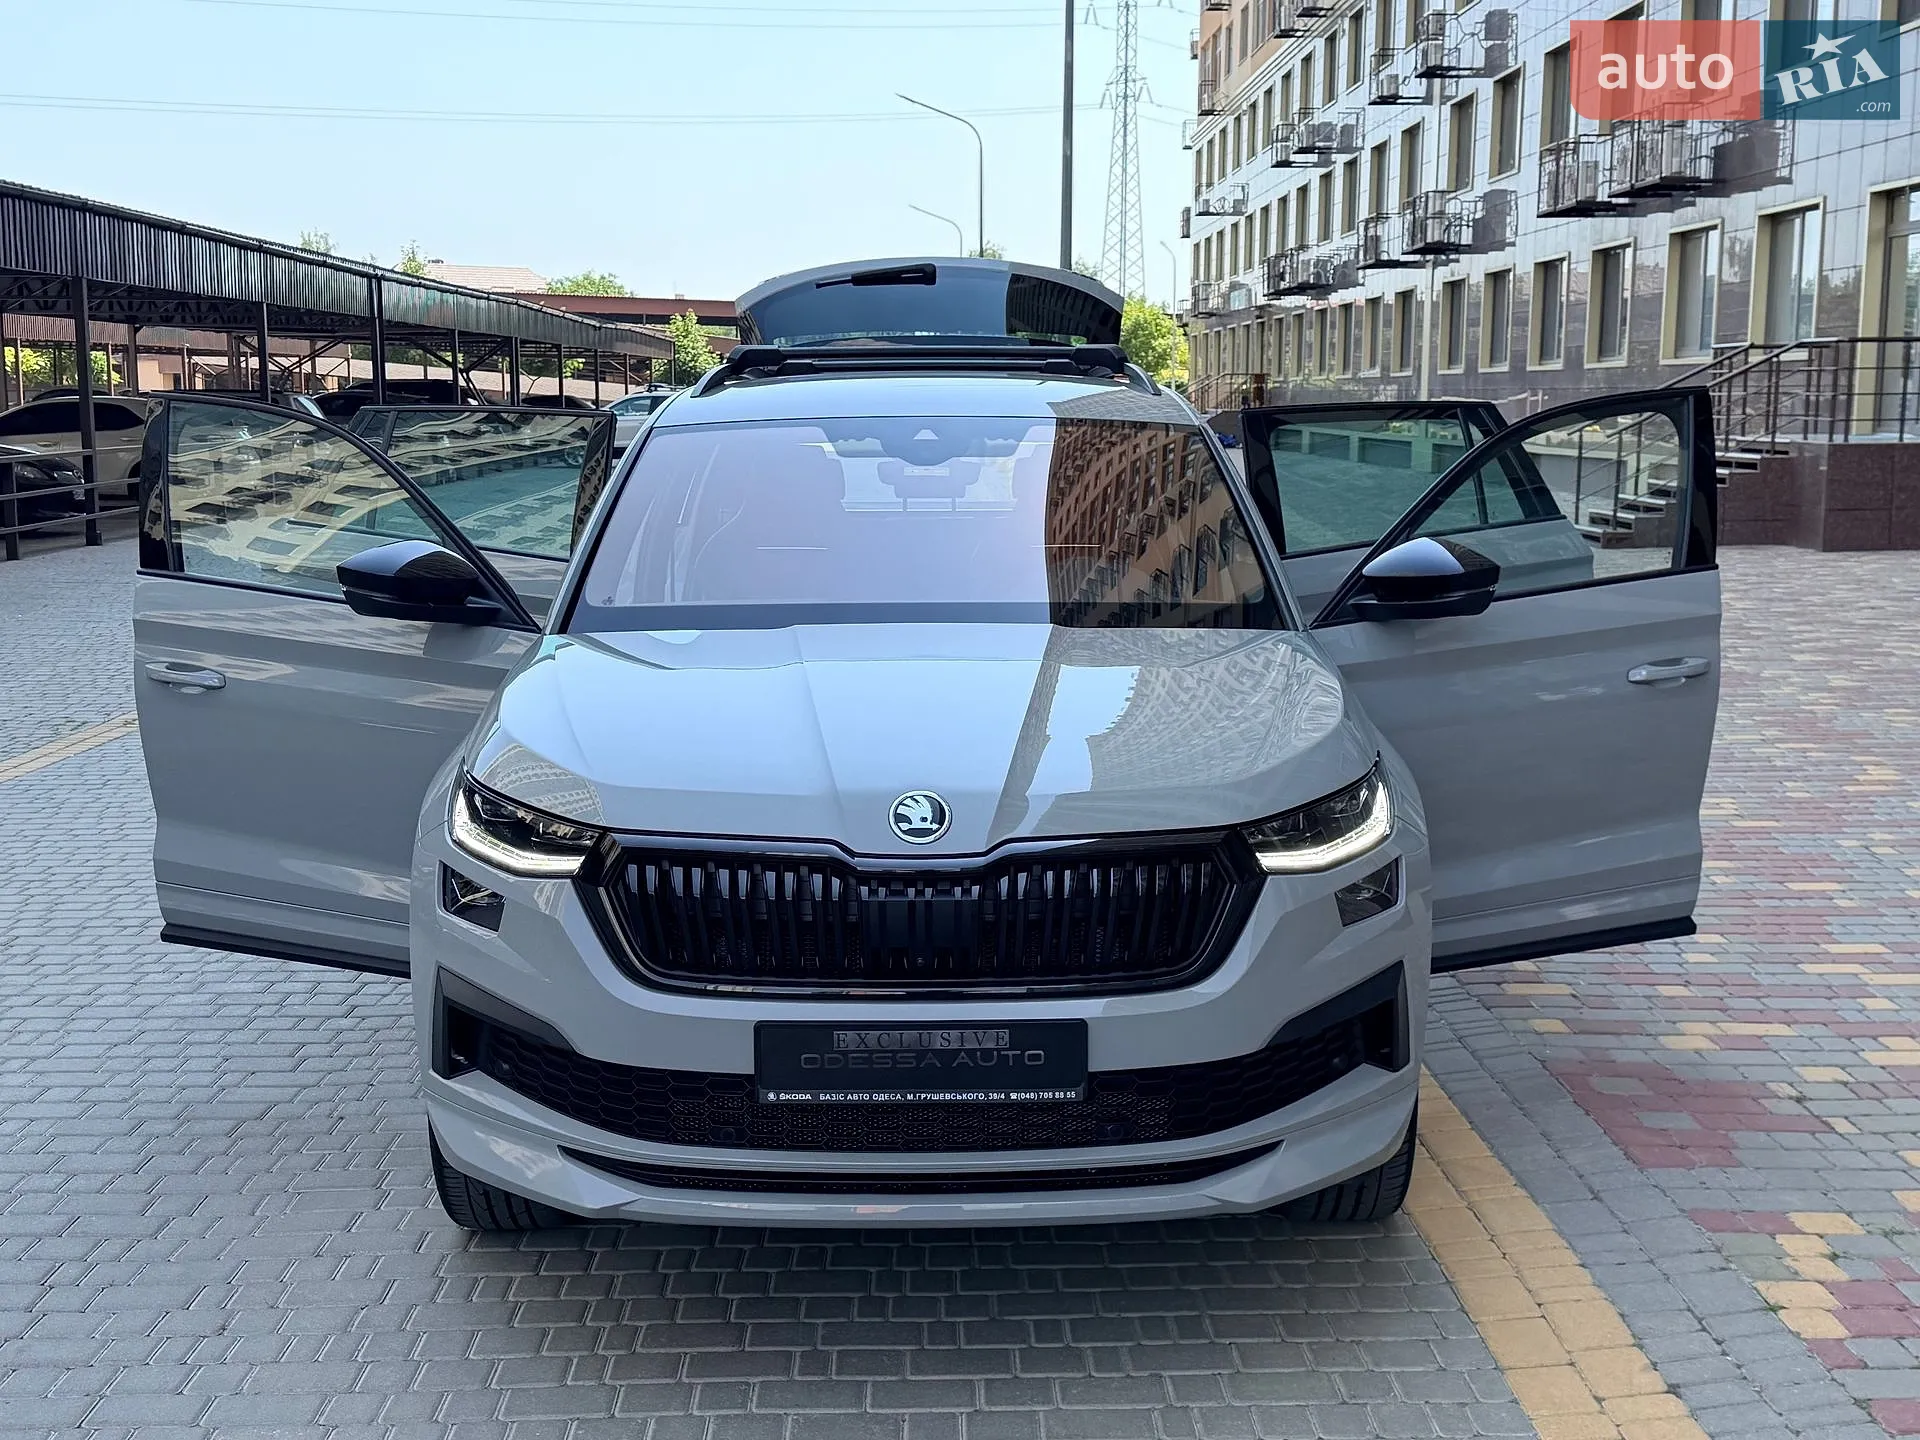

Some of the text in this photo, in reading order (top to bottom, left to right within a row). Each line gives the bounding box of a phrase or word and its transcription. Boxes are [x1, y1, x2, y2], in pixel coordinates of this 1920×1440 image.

[835, 1031, 1008, 1050] EXCLUSIVE
[800, 1050, 1045, 1069] ODESSA AUTO
[819, 1092, 845, 1101] БАЗІС
[846, 1092, 870, 1101] АВТО
